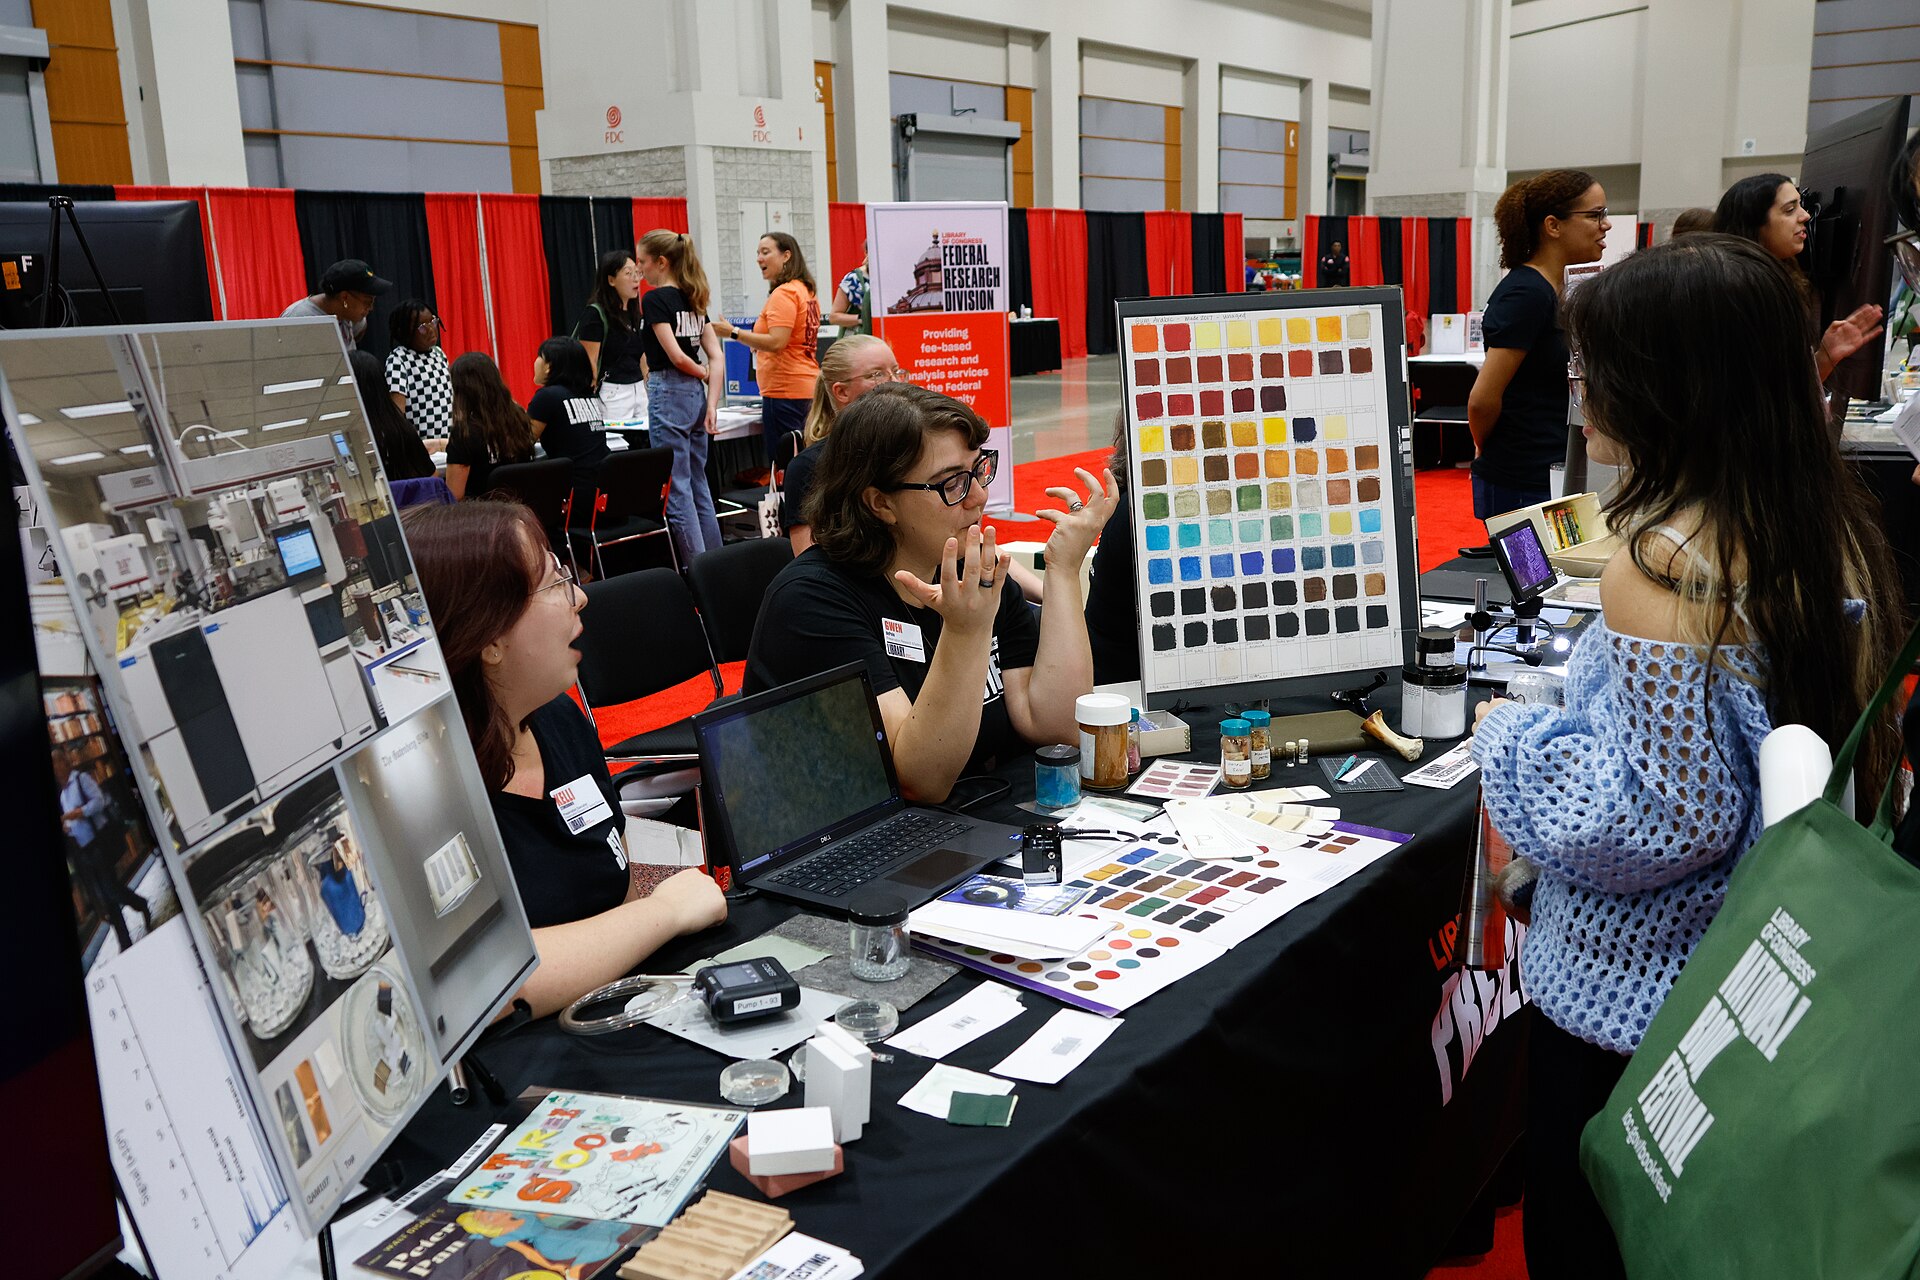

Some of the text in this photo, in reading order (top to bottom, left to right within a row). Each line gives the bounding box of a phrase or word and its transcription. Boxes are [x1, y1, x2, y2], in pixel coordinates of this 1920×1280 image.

[605, 131, 624, 144] FDC
[753, 130, 772, 143] FDC
[942, 244, 989, 266] FEDERAL
[943, 267, 1000, 289] RESEARCH
[945, 290, 994, 311] DIVISION
[923, 328, 968, 340] Providing
[920, 341, 972, 353] fee-based
[914, 354, 979, 367] research and
[909, 368, 989, 382] nalysis services
[927, 383, 943, 392] the
[946, 380, 981, 392] Federal
[884, 620, 902, 633] GWEN
[553, 787, 576, 806] KELLI
[1770, 906, 1811, 950] LIBRARY
[1760, 922, 1816, 987] OF CONGRESS
[737, 1002, 758, 1010] Pump
[1718, 938, 1812, 1063] NATIONAL
[1678, 995, 1740, 1085] BOOK
[1637, 1050, 1715, 1179] FESTIVAL
[481, 1108, 585, 1170] THREE
[1621, 1107, 1672, 1204] loc.gov/bookfest
[385, 1222, 457, 1270] Peter
[408, 1240, 468, 1278] Pan
